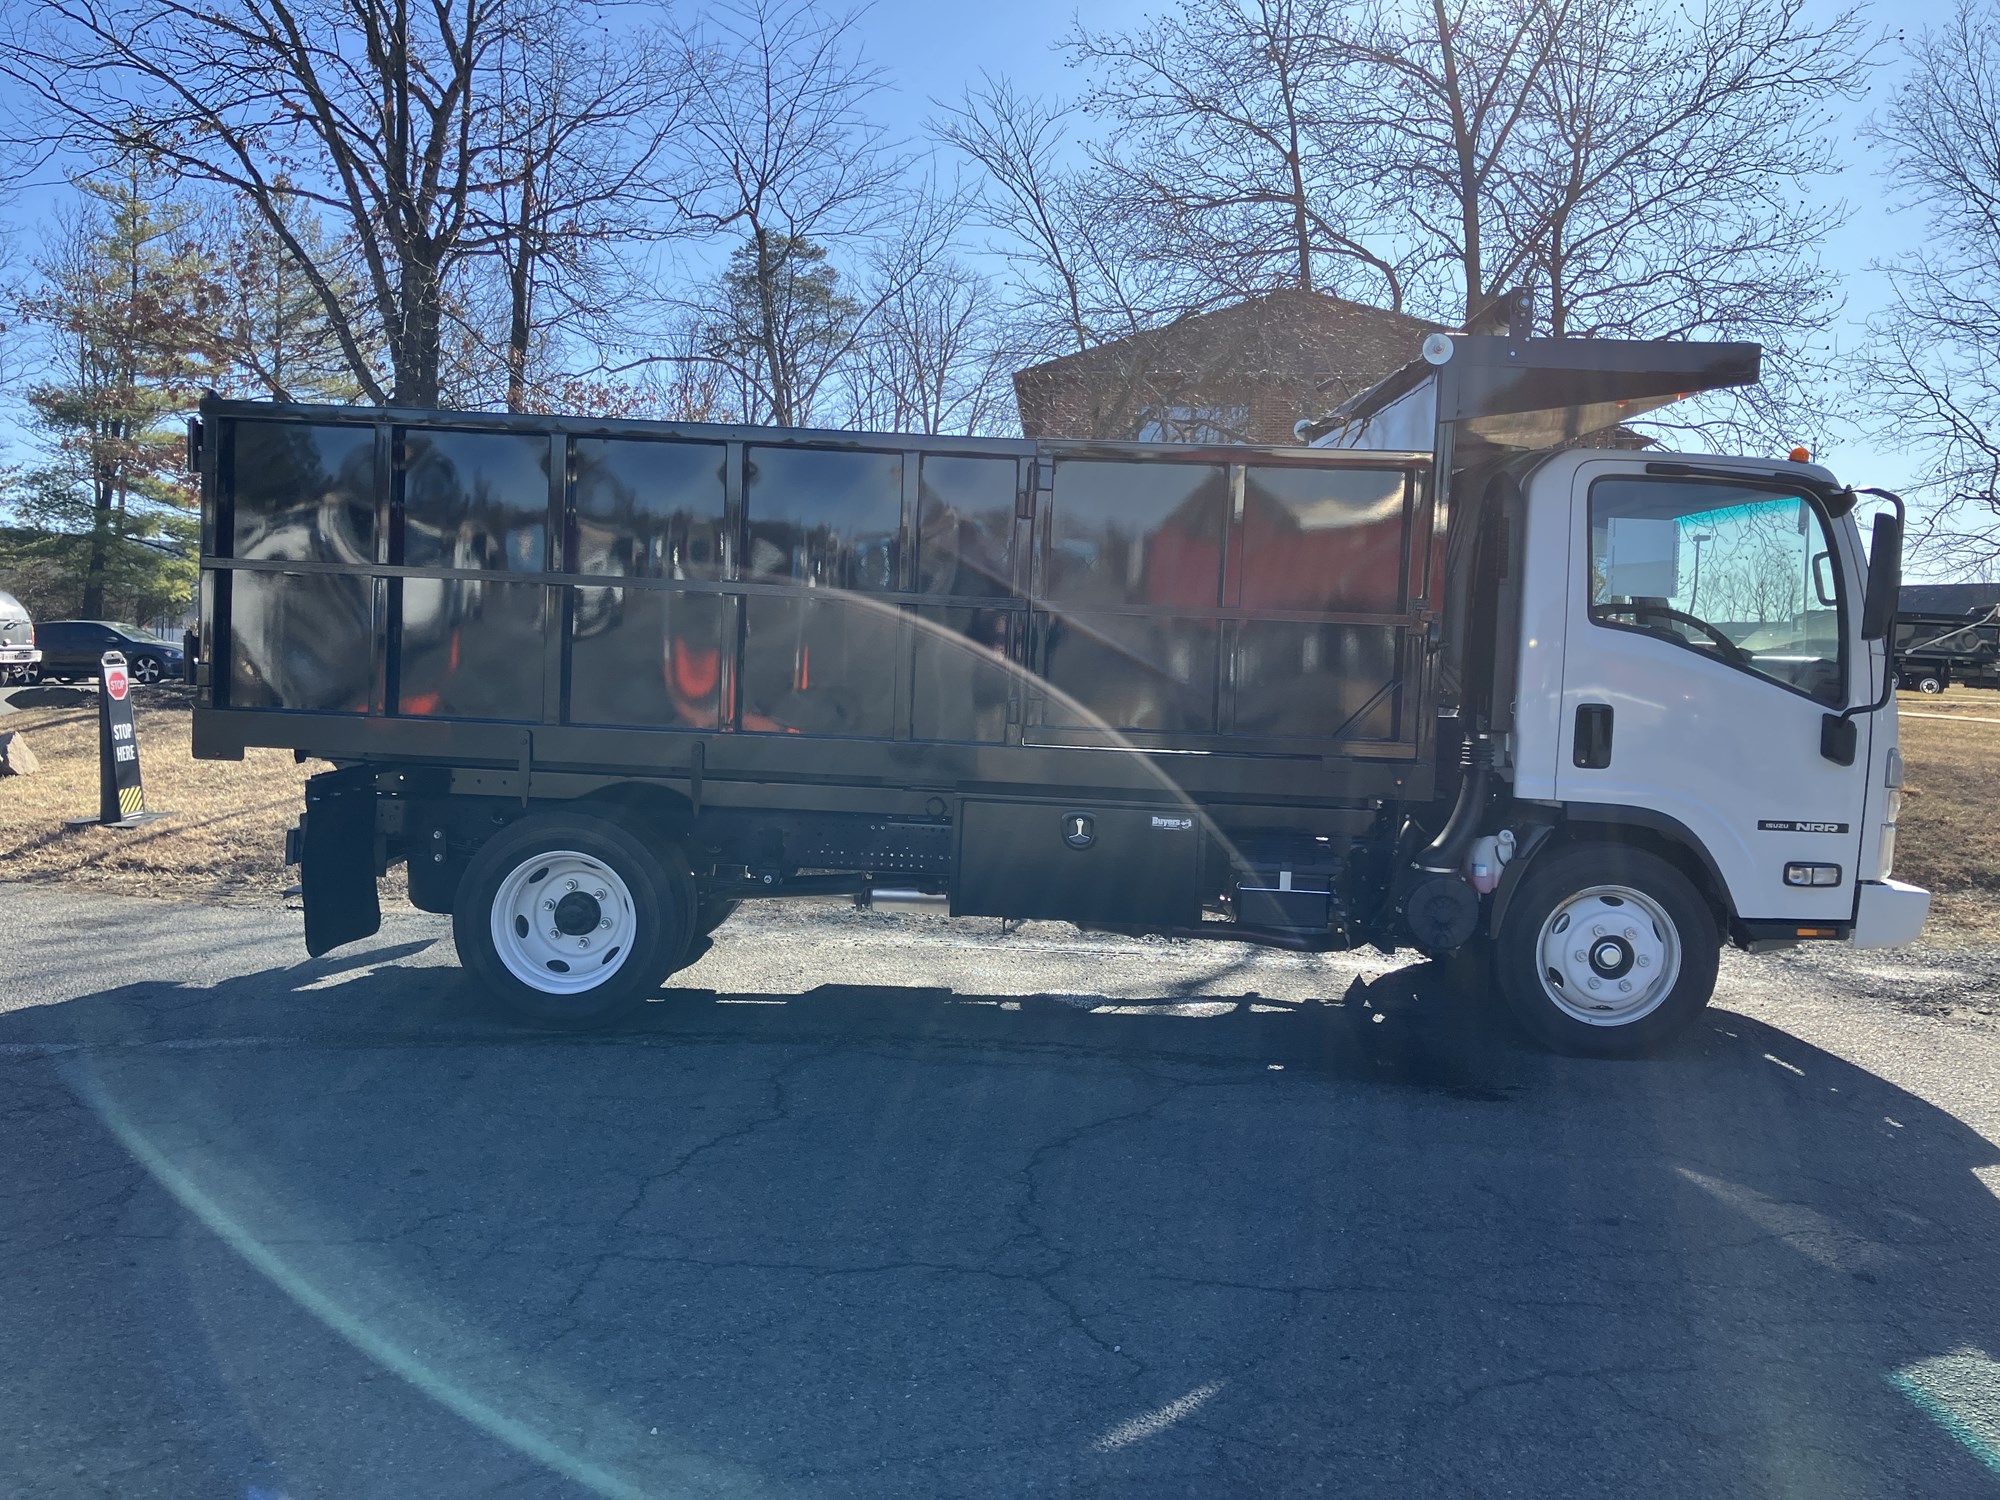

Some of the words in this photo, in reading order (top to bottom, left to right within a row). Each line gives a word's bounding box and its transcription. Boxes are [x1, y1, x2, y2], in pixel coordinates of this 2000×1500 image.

[110, 680, 125, 691] STOP
[113, 723, 132, 741] STOP
[116, 744, 136, 762] HERE
[1152, 816, 1180, 827] Buyers
[1796, 822, 1839, 832] NRR
